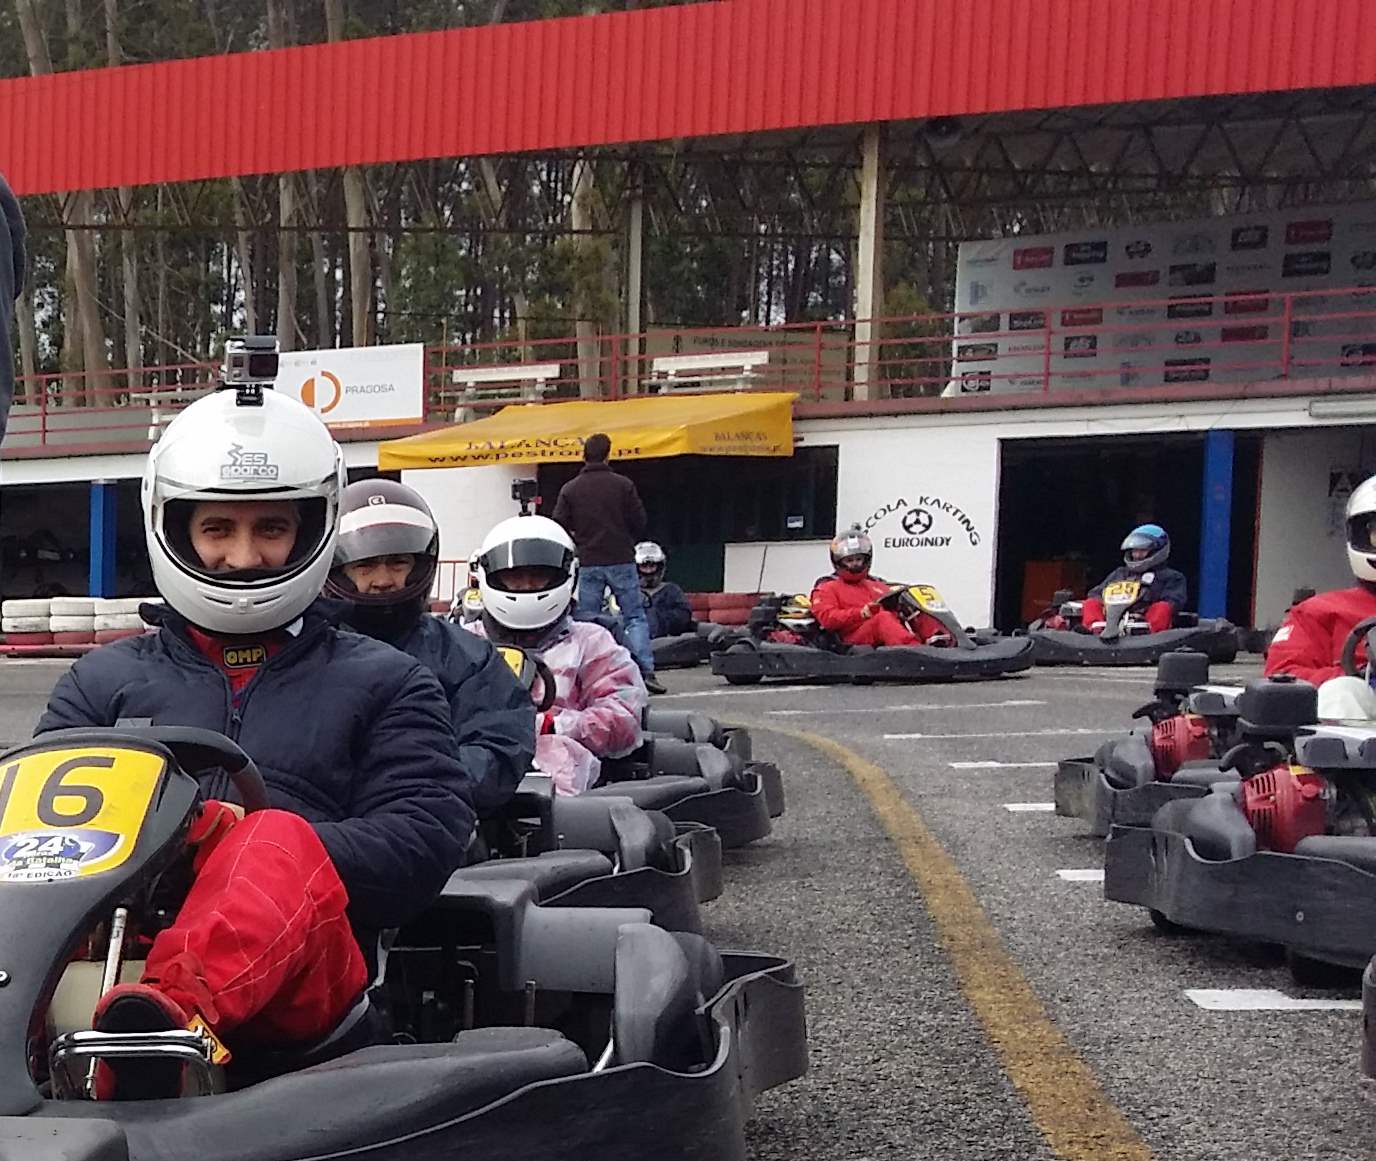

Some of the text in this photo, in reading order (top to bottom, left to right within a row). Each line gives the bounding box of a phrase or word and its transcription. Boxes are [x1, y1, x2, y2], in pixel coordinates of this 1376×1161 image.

[345, 385, 396, 394] PRAGOSA
[864, 496, 981, 546] COLA KARTING
[884, 536, 952, 548] EUROINDY
[226, 648, 262, 664] OMP
[12, 836, 64, 858] 24
